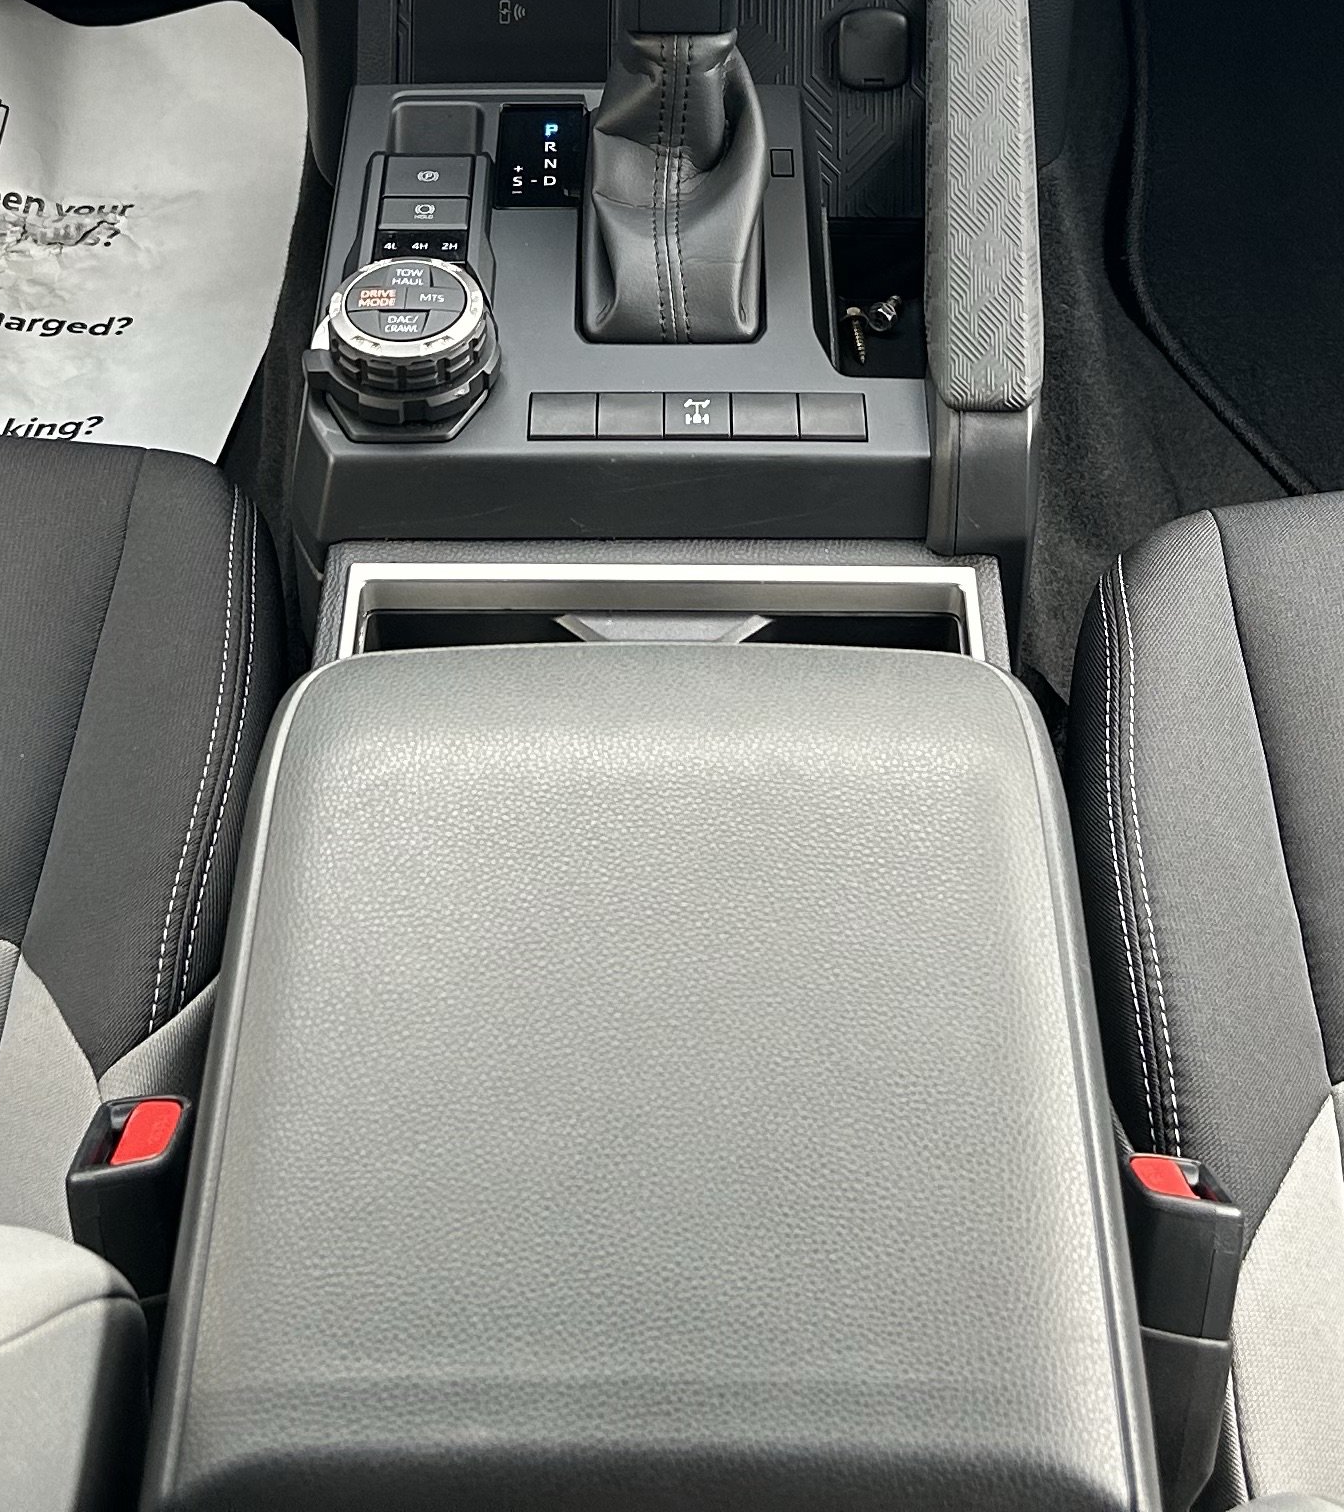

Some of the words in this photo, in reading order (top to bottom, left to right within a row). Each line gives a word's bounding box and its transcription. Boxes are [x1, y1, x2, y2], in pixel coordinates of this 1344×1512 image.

[545, 123, 558, 137] P
[544, 141, 557, 153] R
[544, 158, 557, 169] N
[512, 176, 523, 187] S
[543, 175, 557, 186] D
[412, 242, 429, 250] 4H
[441, 242, 458, 250] 2H
[396, 268, 424, 277] TOW
[391, 278, 424, 286] HAUL
[360, 289, 396, 299] DRIVE
[419, 293, 445, 303] MTS
[358, 298, 396, 308] MODE
[387, 315, 419, 324] DAC/
[384, 324, 419, 334] CRAWL
